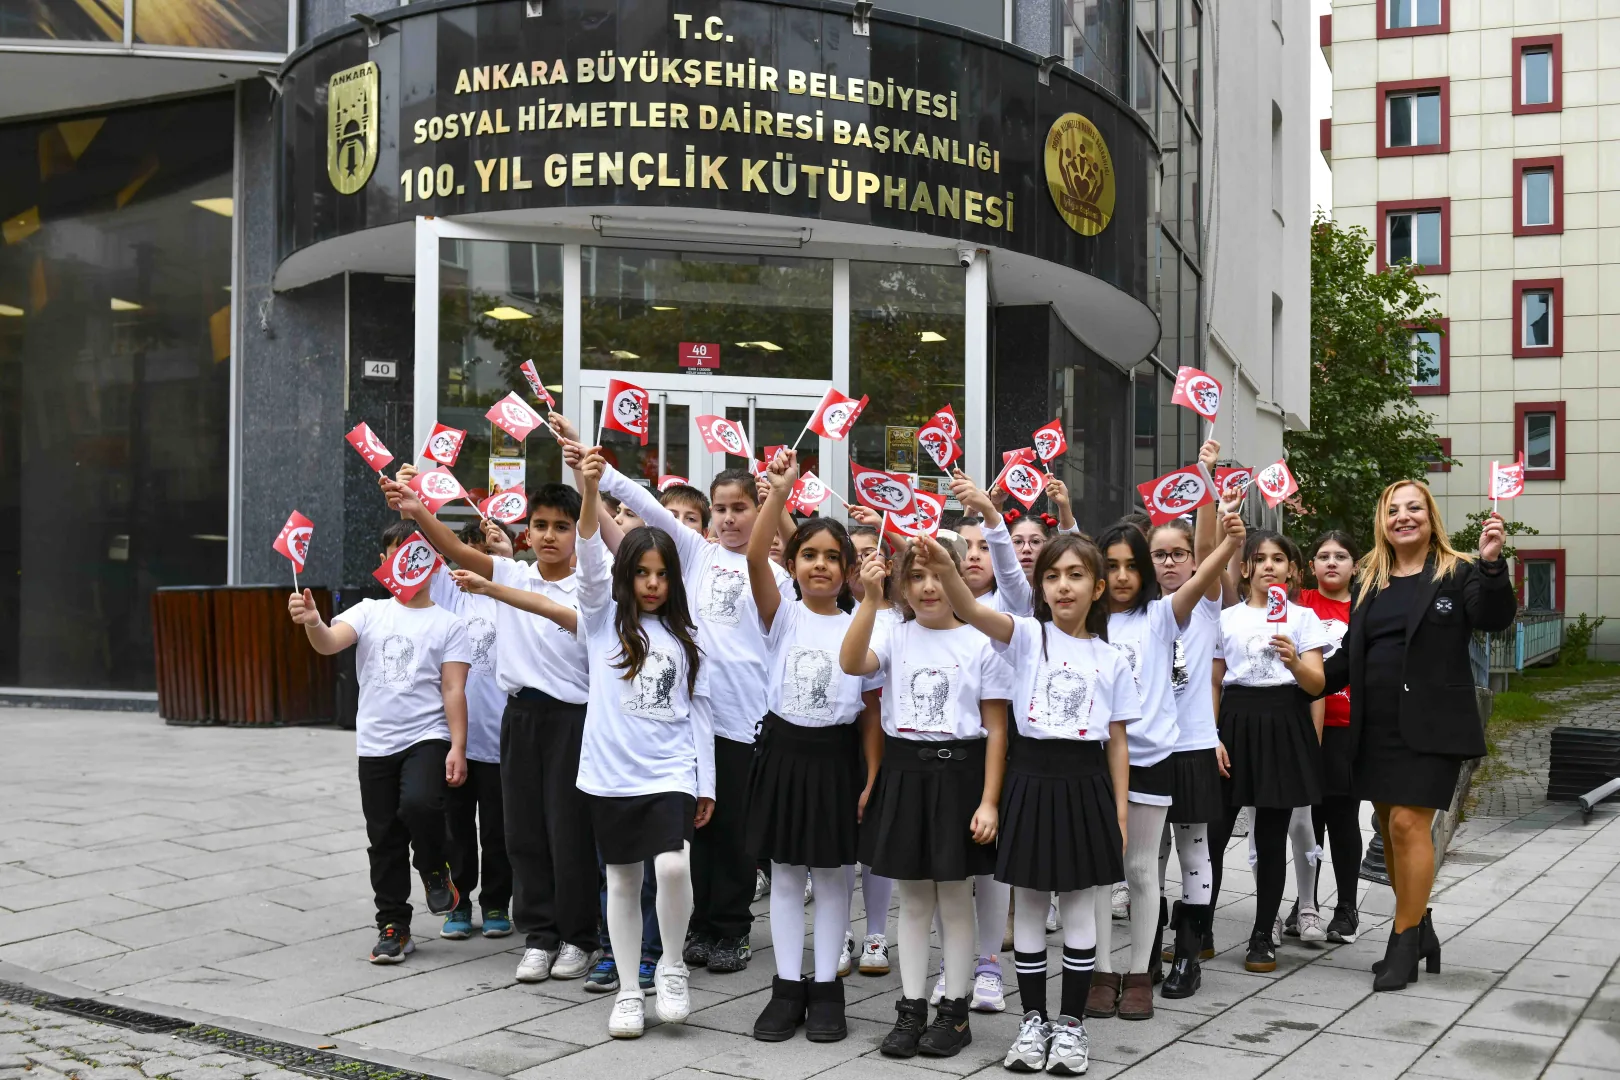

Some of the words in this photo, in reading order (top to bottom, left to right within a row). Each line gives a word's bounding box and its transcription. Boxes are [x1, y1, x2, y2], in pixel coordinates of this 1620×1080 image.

[674, 13, 734, 43] T.C.
[332, 66, 373, 87] ANKARA
[454, 58, 569, 95] ANKARA
[577, 50, 779, 92] BÜYÜKŞEHİR
[788, 68, 958, 121] BELEDİYESİ
[413, 108, 511, 145] SOSYAL
[518, 98, 690, 132] HİZMETLER
[699, 102, 824, 142] DAİRESİ
[833, 119, 1001, 175] BAŞKANLIĞI
[400, 163, 465, 203] 100.
[474, 157, 533, 193] YIL
[544, 144, 729, 191] GENÇLİK
[741, 152, 1015, 233] KÜTÜPHANESİ
[691, 344, 707, 356] 40
[371, 364, 390, 375] 40
[697, 358, 703, 366] A
[1176, 376, 1186, 395] ATA
[496, 418, 516, 434] ATA
[701, 425, 715, 445] ATA
[356, 441, 375, 462] ATA
[1143, 495, 1156, 517] ATA
[278, 520, 294, 540] ATA
[383, 577, 403, 596] ATA
